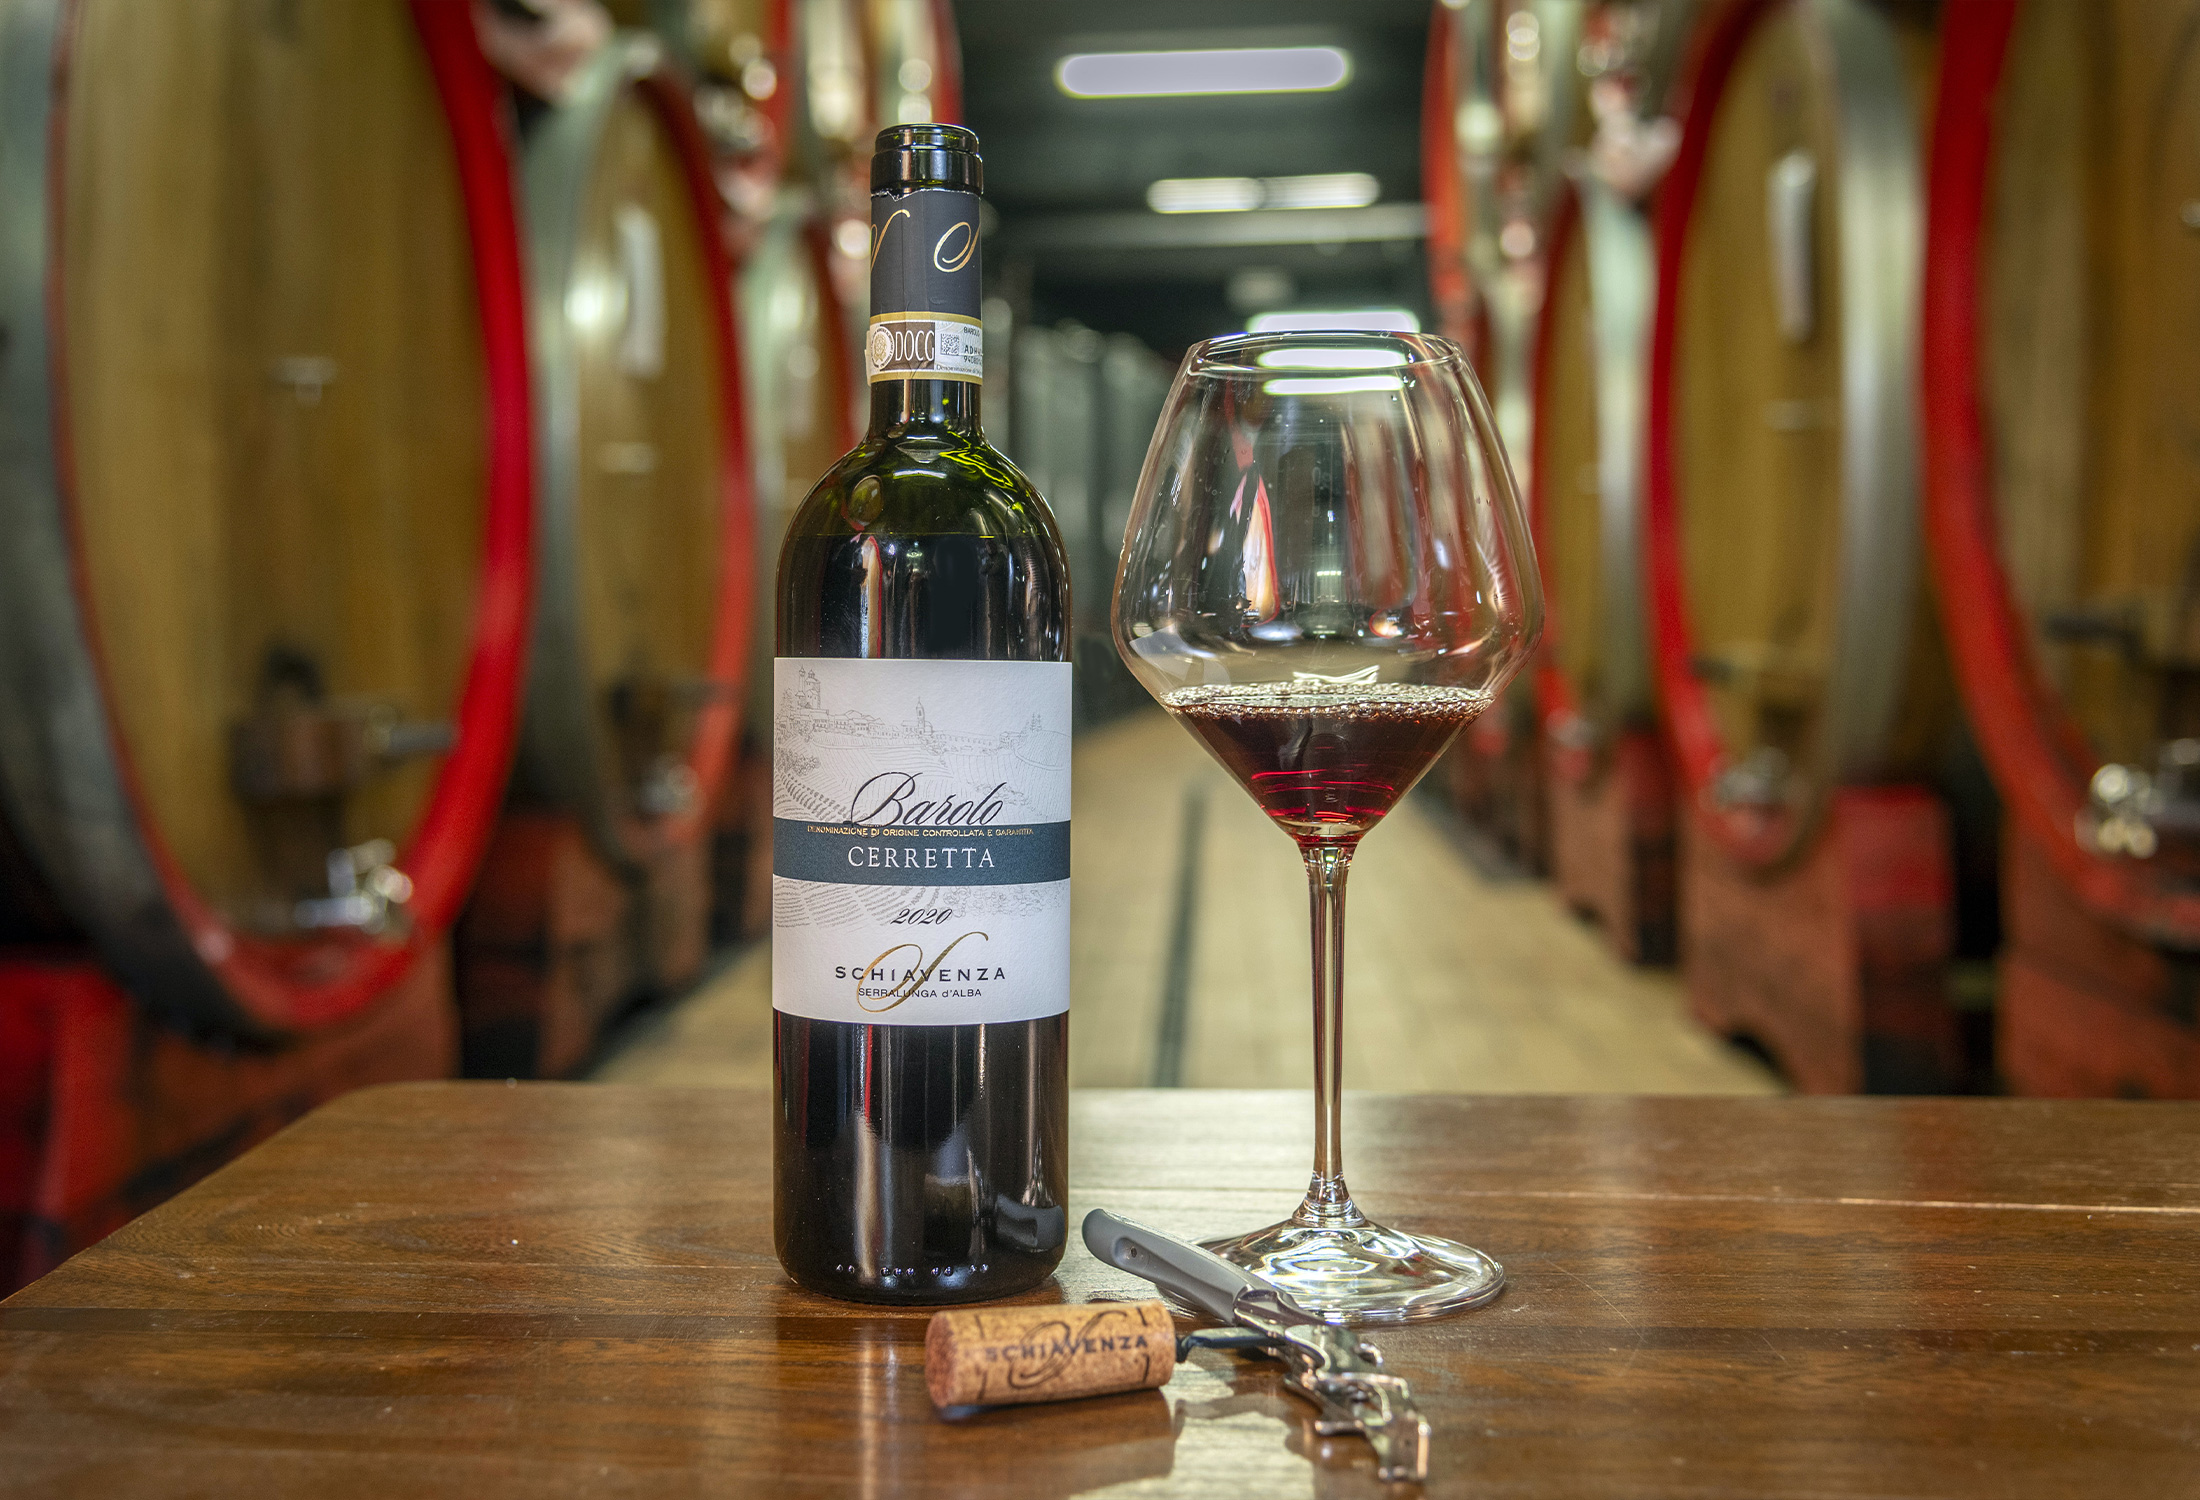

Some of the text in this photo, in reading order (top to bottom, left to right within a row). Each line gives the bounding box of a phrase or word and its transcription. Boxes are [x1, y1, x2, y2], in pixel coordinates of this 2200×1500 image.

[895, 330, 935, 361] DOCG
[843, 771, 1007, 828] Barolo
[807, 825, 1034, 837] DENOMINAZIONE DI ORIGINE CONTROLLATA E GARANTITA
[848, 846, 995, 868] CERRETTA
[890, 908, 953, 926] 2020
[835, 966, 1006, 983] SCHIAVENZA
[858, 987, 982, 998] SERRALUNGA d'ALBA
[984, 1335, 1148, 1363] SCHIAVENZA
